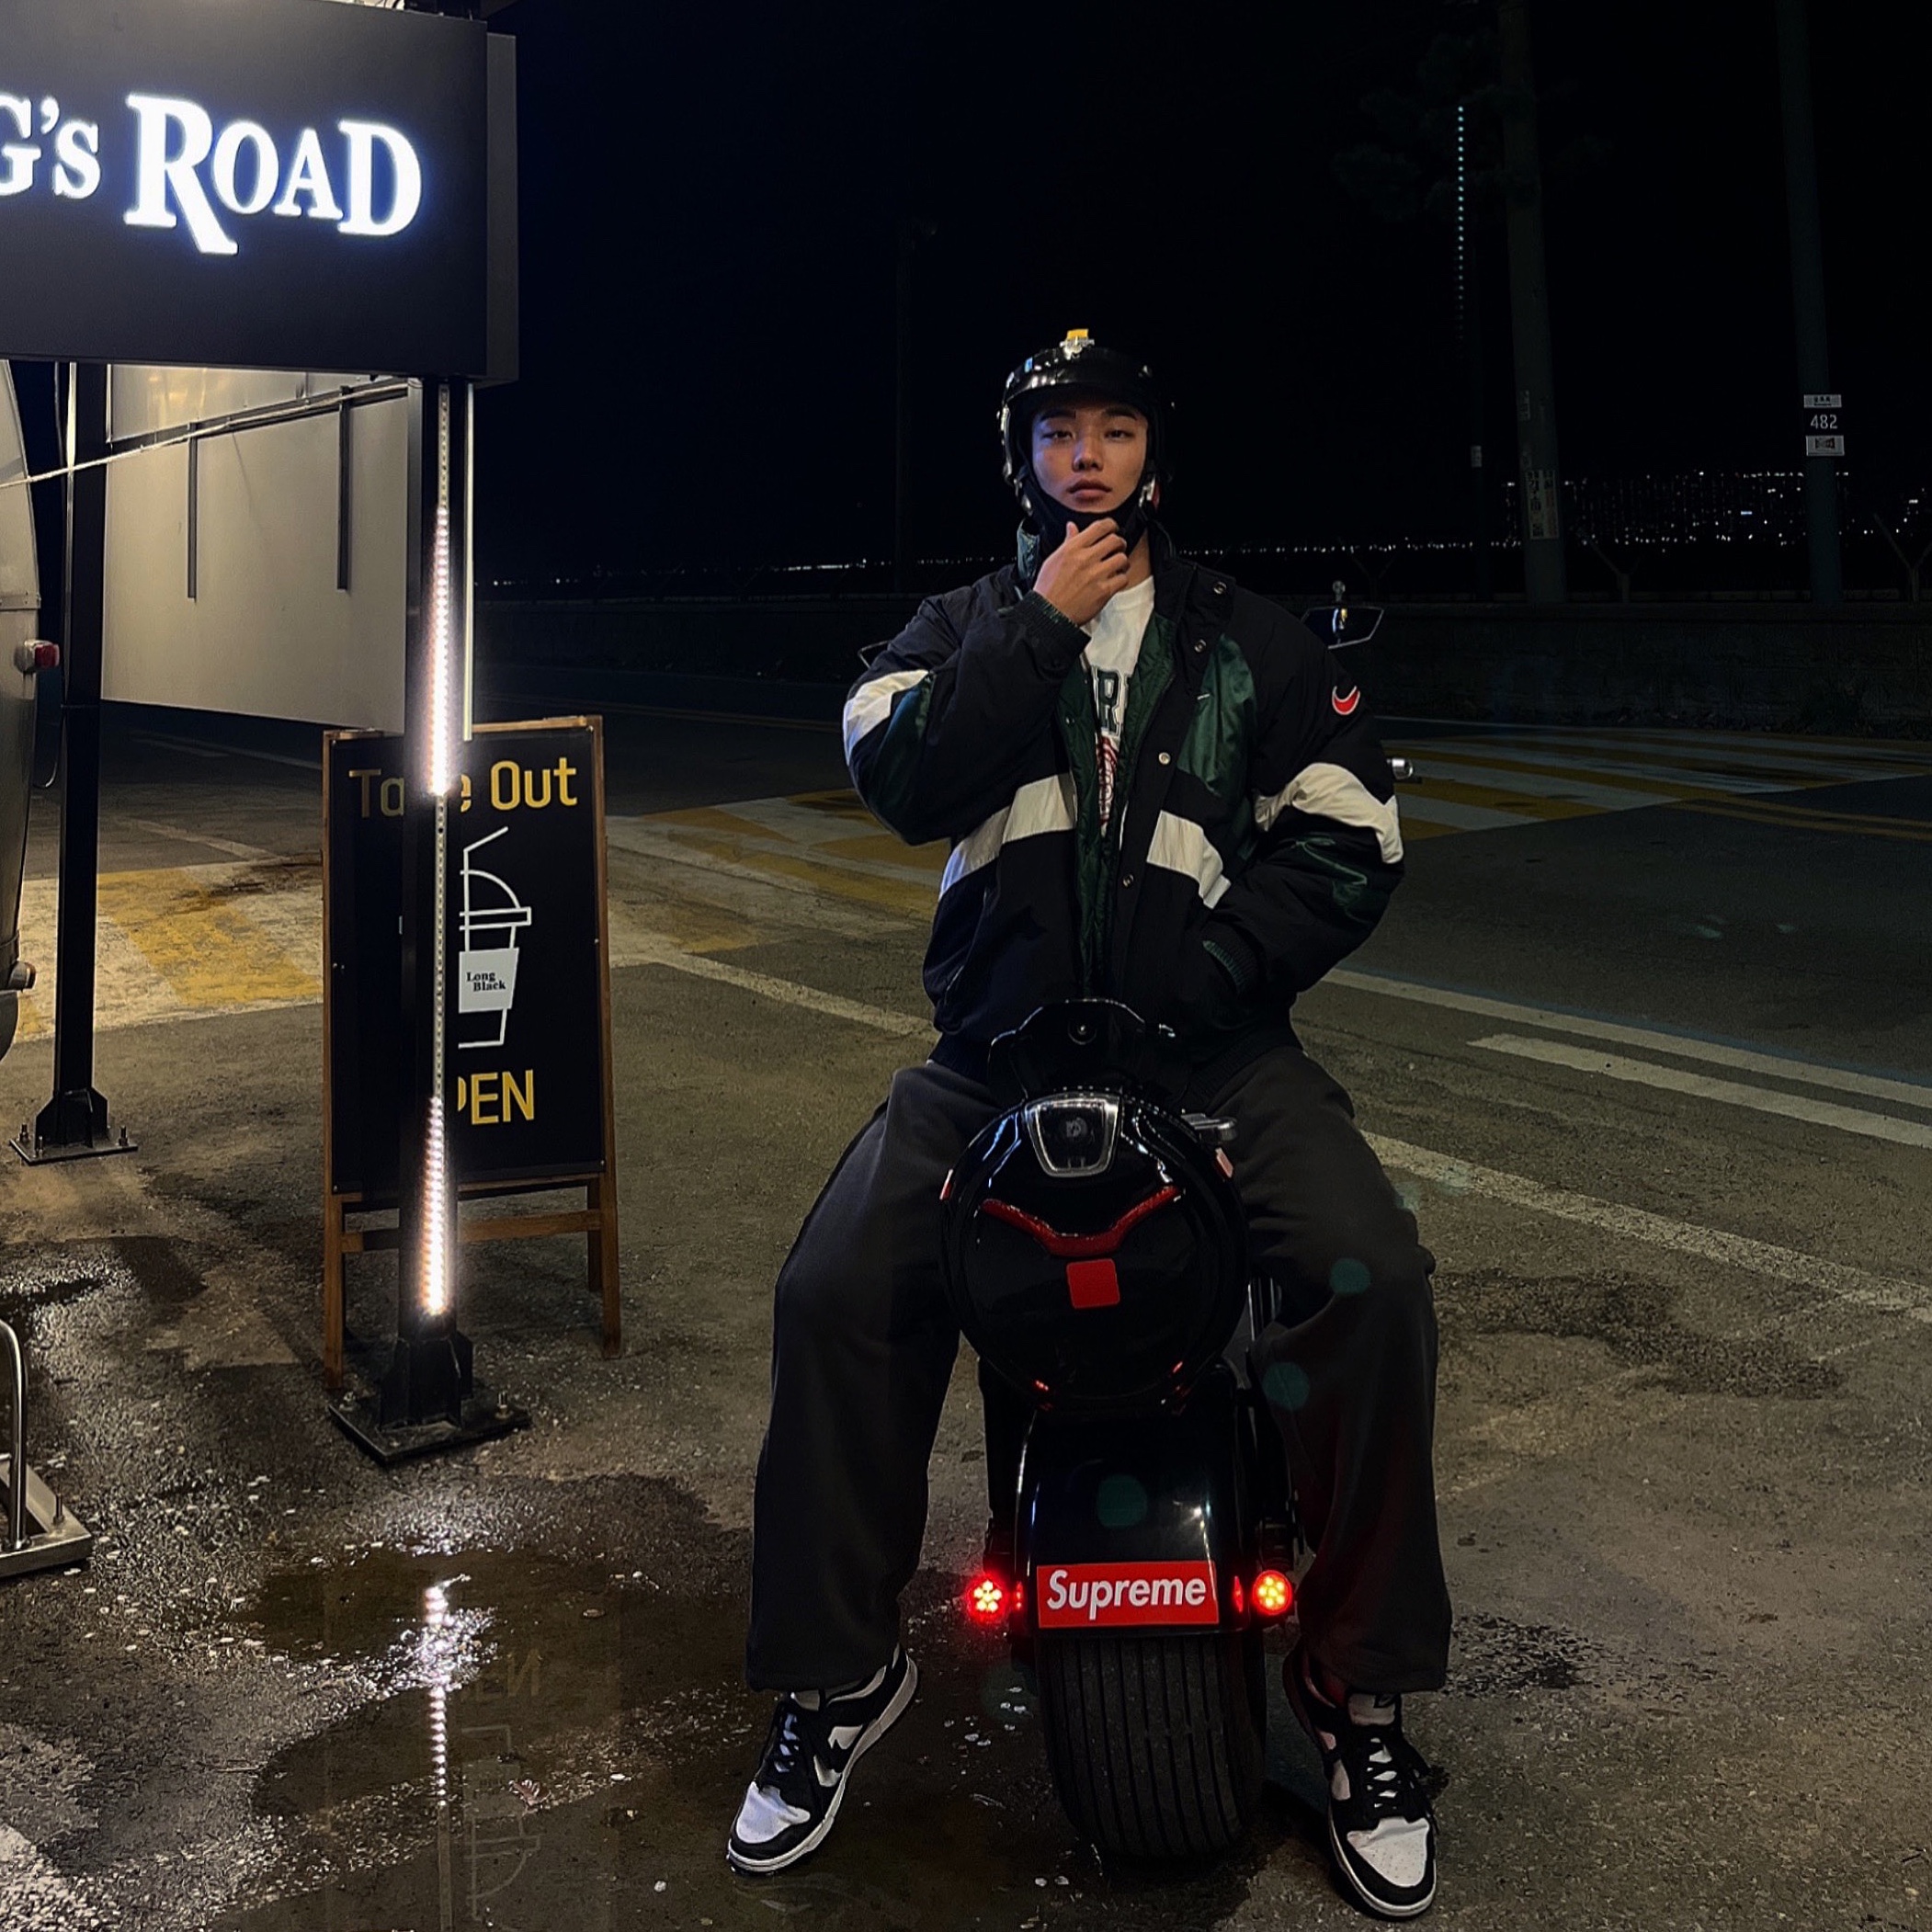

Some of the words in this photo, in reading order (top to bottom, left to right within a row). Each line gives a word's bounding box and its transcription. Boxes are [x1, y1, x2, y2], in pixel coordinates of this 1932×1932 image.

[123, 93, 422, 256] ROAD
[1810, 414, 1838, 429] 482
[348, 767, 472, 819] Ta
[490, 756, 578, 812] Out
[466, 971, 496, 983] Long
[472, 979, 506, 992] Black
[457, 1068, 535, 1126] EN
[1046, 1569, 1206, 1620] Supreme
